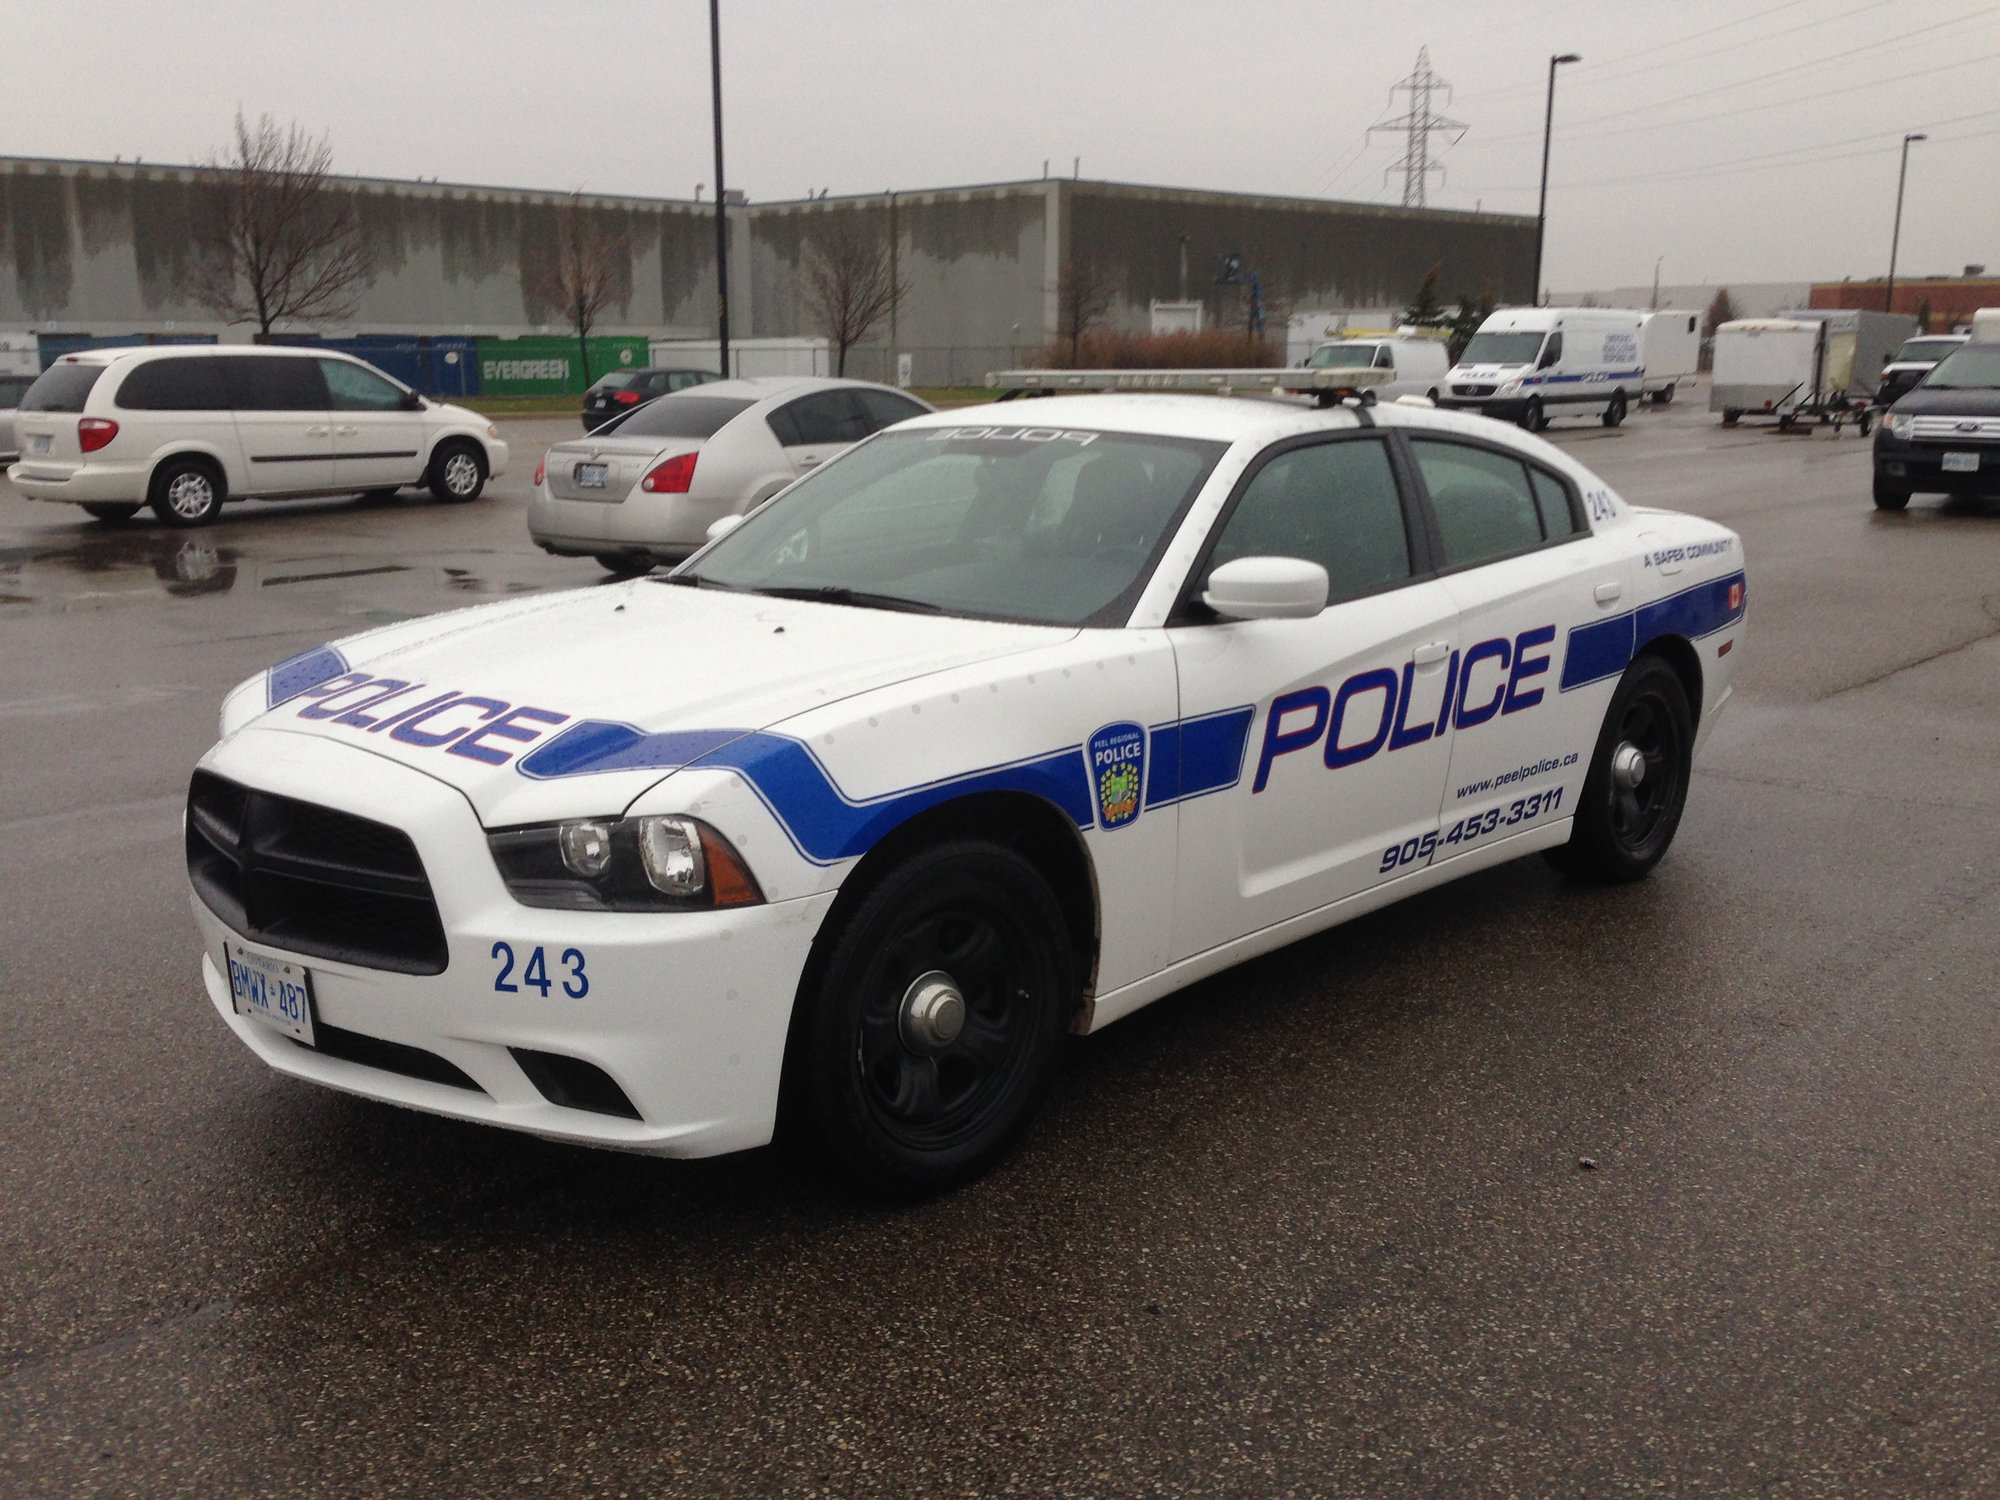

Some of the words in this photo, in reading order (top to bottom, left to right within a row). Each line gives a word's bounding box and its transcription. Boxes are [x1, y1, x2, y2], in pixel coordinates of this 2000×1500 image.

[483, 359, 570, 380] EVERGREEN
[1586, 488, 1618, 522] 243
[1644, 553, 1653, 568] A
[1653, 547, 1687, 566] SAFER
[296, 672, 572, 767] POLICE
[1252, 624, 1557, 795] POLICE
[1094, 740, 1109, 750] PEEL
[1109, 732, 1140, 746] REGIONAL
[1095, 742, 1142, 767] POLICE
[1456, 751, 1580, 799] www.peelpolice.ca
[1378, 786, 1564, 874] 905-453-3311
[491, 941, 590, 999] 243
